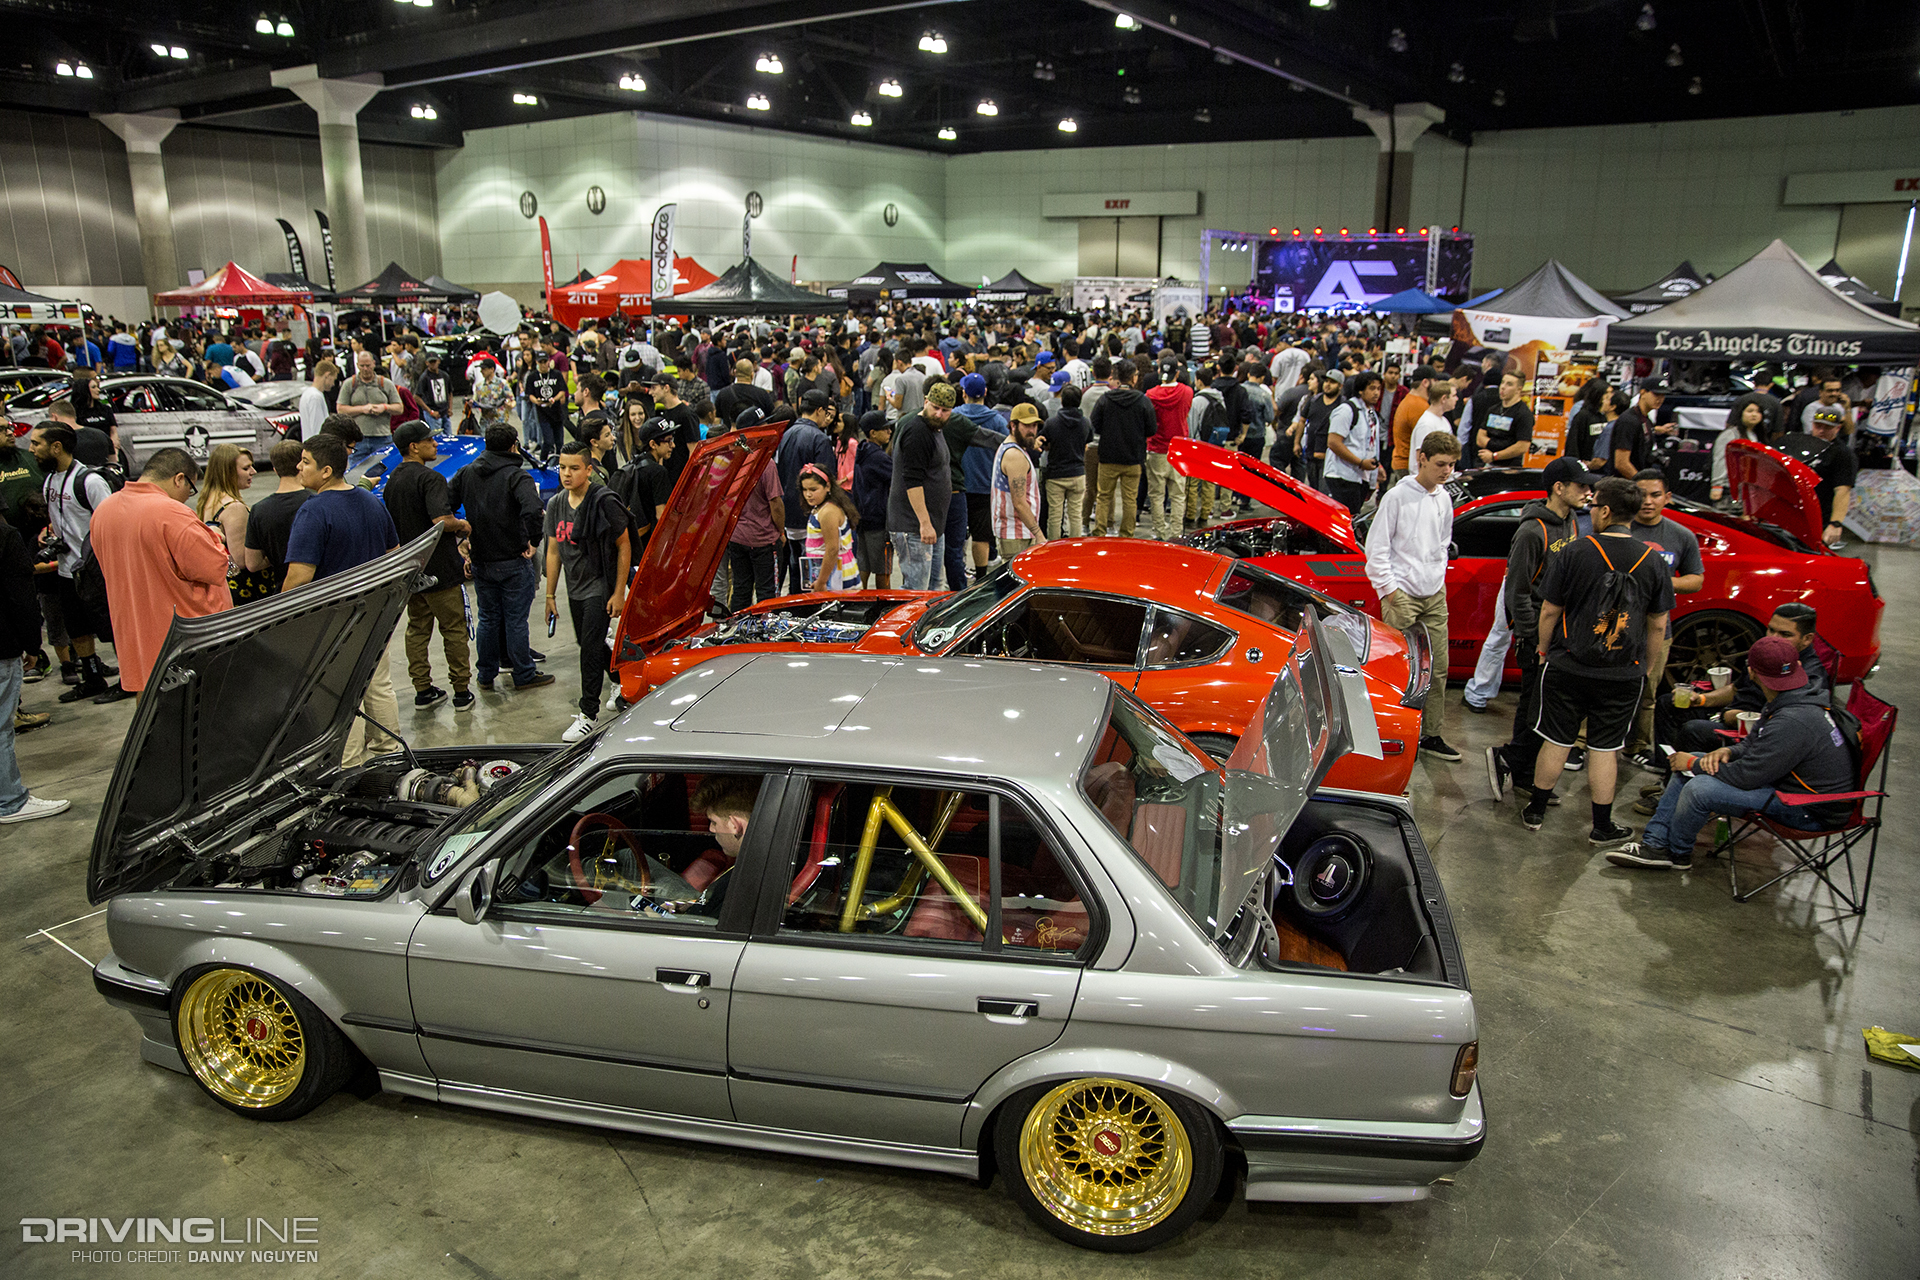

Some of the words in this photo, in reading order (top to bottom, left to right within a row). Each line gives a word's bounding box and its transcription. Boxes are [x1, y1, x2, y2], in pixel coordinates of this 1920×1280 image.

[1104, 199, 1131, 210] EXIT
[1654, 329, 1694, 352] Los
[1693, 329, 1784, 356] Angeles
[1786, 332, 1863, 358] Times
[1098, 1133, 1119, 1153] BBS
